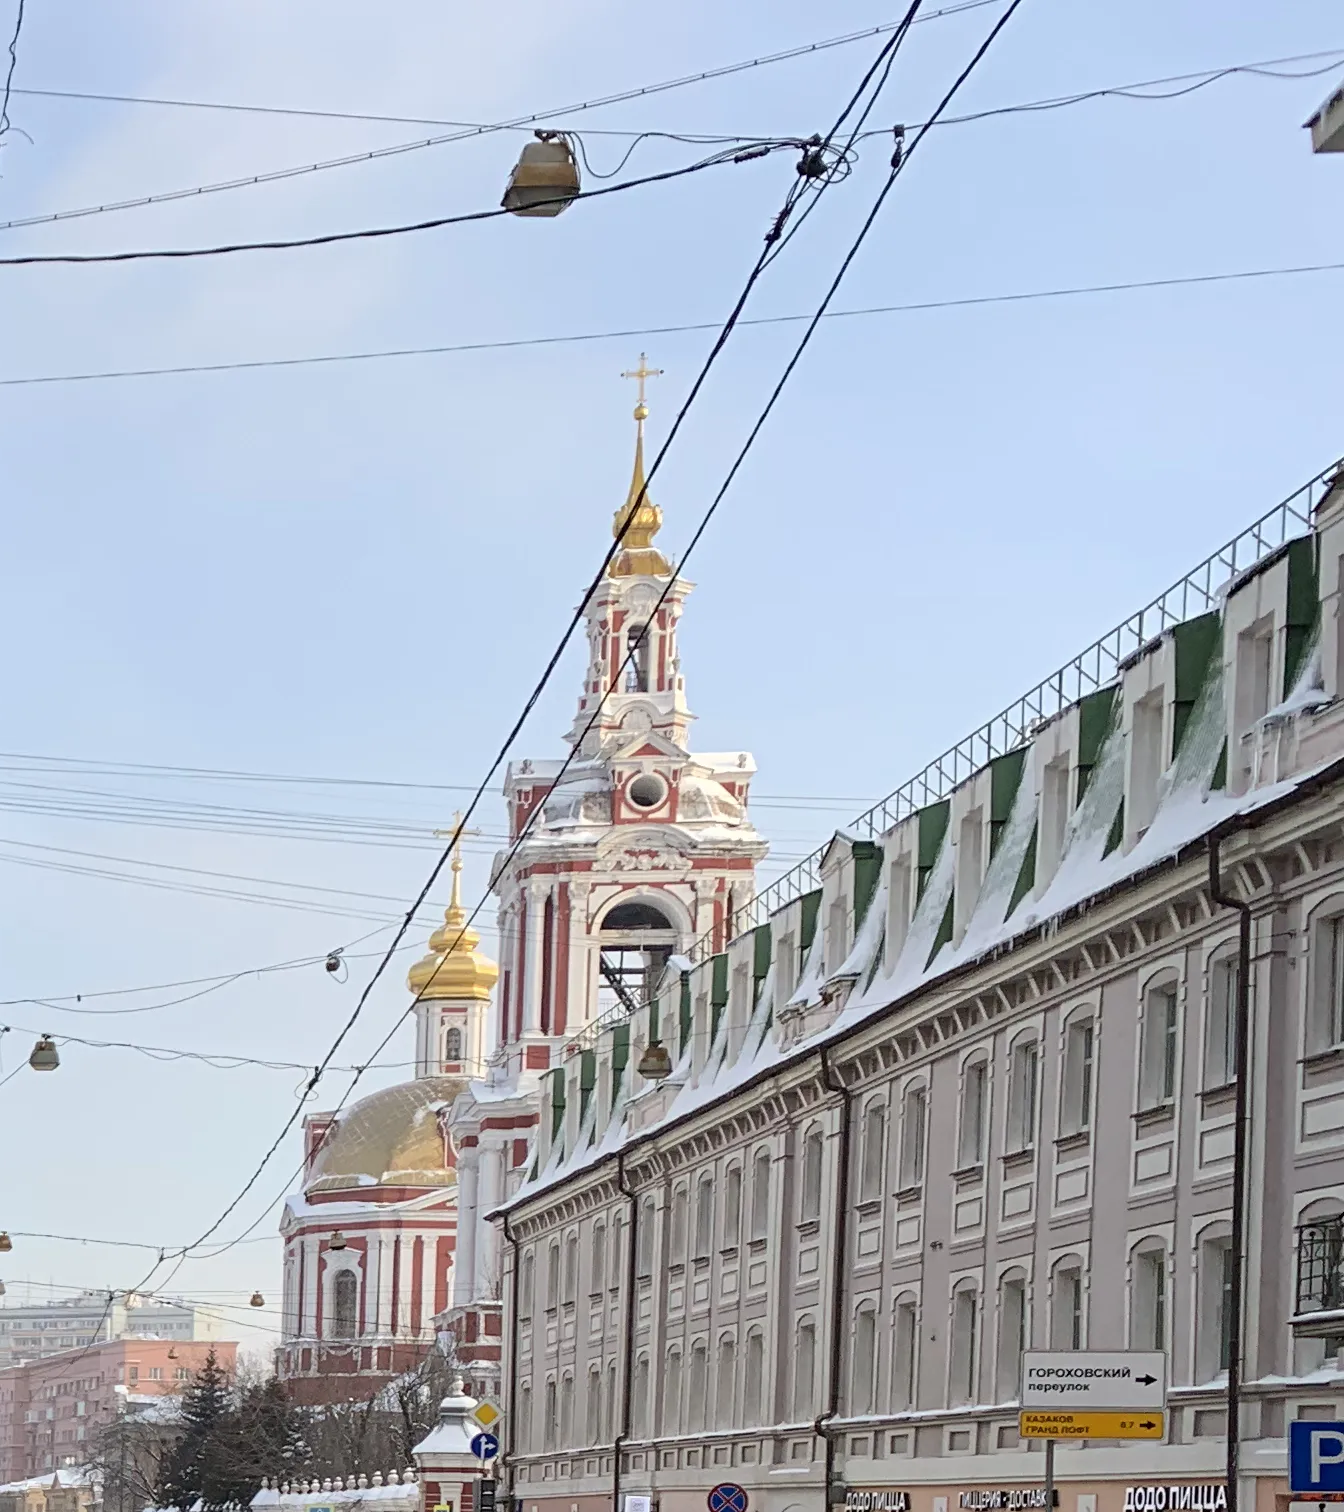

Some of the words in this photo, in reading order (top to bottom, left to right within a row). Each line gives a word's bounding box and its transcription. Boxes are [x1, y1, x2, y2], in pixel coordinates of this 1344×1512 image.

[1028, 1367, 1131, 1378] ГОРОХОВСКИЙ
[1028, 1383, 1090, 1393] переулок
[1025, 1415, 1074, 1423] КАЗАКОВ
[1025, 1426, 1059, 1435] ГРАНД
[1061, 1426, 1090, 1434] ЛОФТ
[1310, 1430, 1344, 1483] P
[958, 1491, 1002, 1511] ПИЦЦЕРИЯ
[1009, 1489, 1052, 1510] ДОСТАВК
